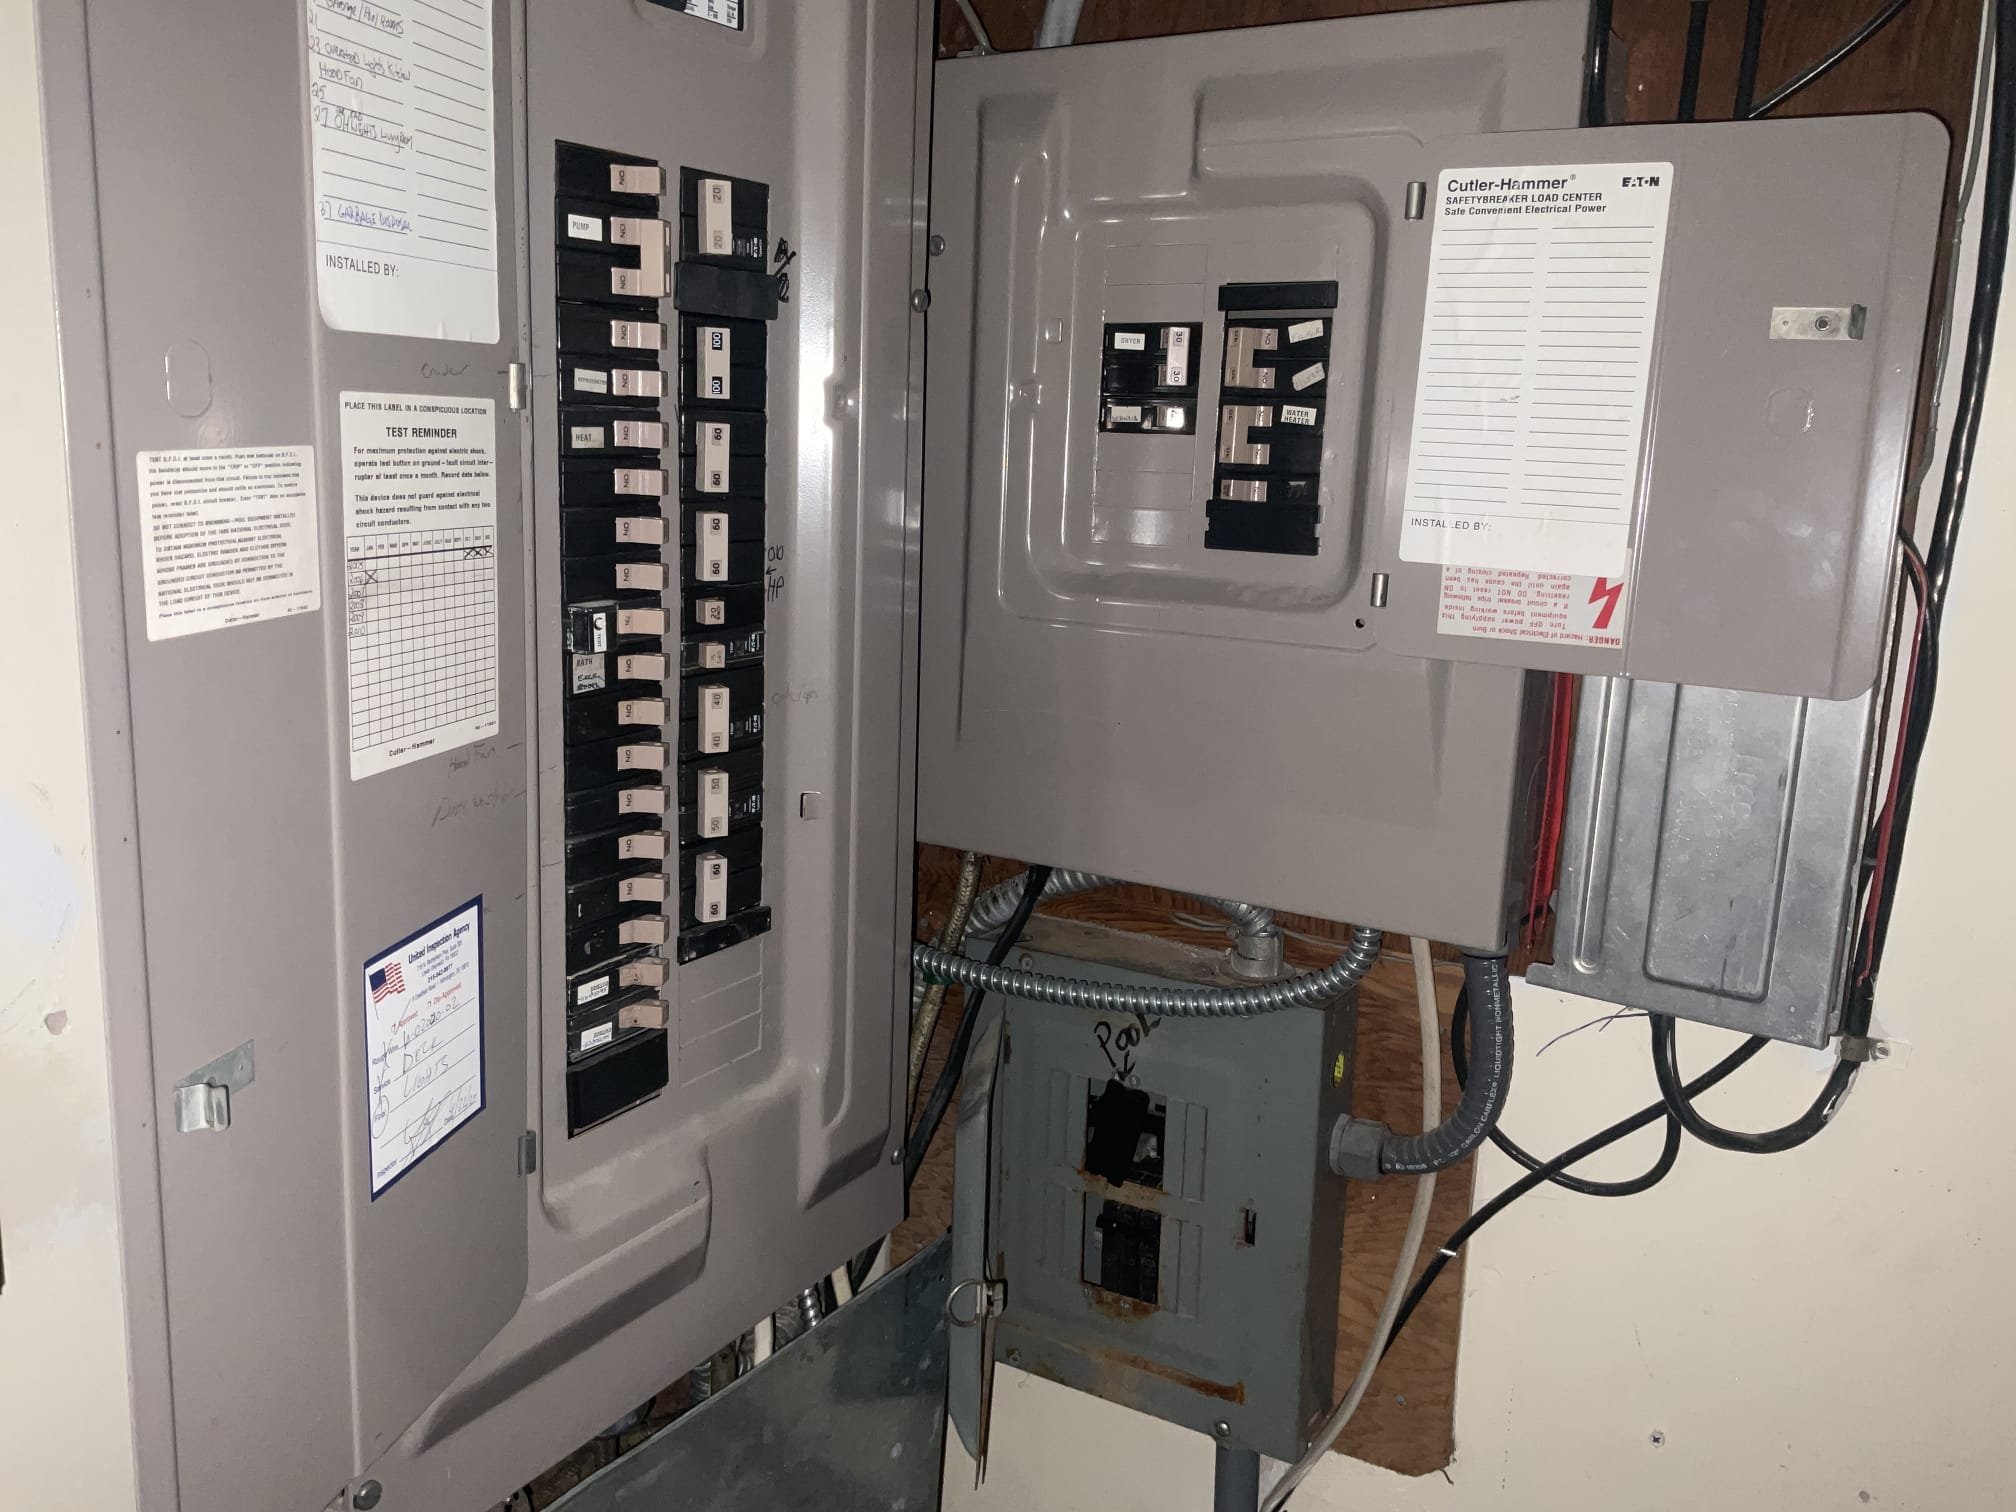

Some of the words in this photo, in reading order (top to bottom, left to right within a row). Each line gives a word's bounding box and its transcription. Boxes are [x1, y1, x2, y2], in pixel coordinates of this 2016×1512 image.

[312, 82, 327, 100] 25
[314, 105, 329, 128] 27
[618, 169, 625, 185] ON
[713, 187, 722, 201] 20
[1446, 193, 1529, 205] SAFETYBREAKER
[1531, 193, 1558, 203] LOAD
[1561, 192, 1602, 202] CENTER
[1445, 207, 1466, 217] Safe
[1468, 205, 1522, 216] Convenient
[1525, 204, 1572, 214] Electrical
[1575, 203, 1607, 213] Power
[572, 220, 590, 232] PUMP
[620, 223, 626, 239] ON
[714, 235, 723, 249] 20
[326, 254, 380, 275] INSTALLED
[384, 263, 399, 279] BY:
[619, 274, 626, 290] ON
[620, 325, 627, 340] ON
[1175, 331, 1183, 343] 30
[713, 333, 721, 348] 100
[622, 373, 629, 389] ON
[1173, 370, 1181, 383] 30
[713, 379, 721, 394] 100
[345, 402, 365, 410] PLACE
[368, 402, 382, 410] THIS
[405, 404, 411, 412] IN
[419, 405, 459, 414] CONSPICUOUS
[461, 407, 487, 415] LOCATION
[1286, 409, 1309, 418] WATER
[1284, 416, 1309, 425] HEATER
[386, 427, 408, 438] TEST
[412, 428, 457, 439] REMINDER
[575, 433, 592, 442] HEAT
[623, 425, 629, 440] ON
[713, 428, 722, 440] 60
[353, 447, 365, 455] For
[366, 447, 395, 455] maximum
[398, 447, 426, 456] protection
[427, 448, 447, 456] against
[354, 460, 377, 468] operate
[392, 459, 411, 467] button
[623, 473, 629, 488] ON
[712, 473, 721, 486] 60
[355, 494, 368, 502] This
[418, 492, 434, 500] guard
[436, 491, 455, 499] against
[356, 507, 373, 515] shock
[375, 506, 395, 514] hazard
[397, 505, 422, 513] resulting
[356, 520, 376, 528] circuit
[378, 518, 411, 527] conductors.
[624, 521, 630, 536] ON
[712, 518, 720, 531] 60
[624, 567, 630, 582] ON
[712, 562, 720, 576] 60
[1467, 567, 1493, 576] closing
[1497, 570, 1530, 579] Repeated
[767, 575, 785, 602] HP
[711, 607, 717, 619] 20
[1441, 612, 1455, 620] this
[1470, 605, 1498, 614] working
[1503, 609, 1525, 617] before
[1530, 611, 1567, 620] equipment
[1460, 613, 1496, 622] supplying
[1472, 625, 1488, 634] Burn
[1498, 628, 1518, 636] Shock
[1549, 621, 1565, 630] Turn
[1520, 629, 1549, 639] Electrical
[625, 658, 632, 673] ON
[714, 693, 721, 706] 40
[626, 704, 632, 718] ON
[714, 735, 721, 748] 40
[625, 749, 632, 763] ON
[712, 778, 720, 790] 50
[626, 794, 632, 807] ON
[711, 819, 720, 832] 50
[626, 839, 632, 853] ON
[713, 864, 721, 876] 60
[627, 882, 633, 896] ON
[711, 904, 719, 916] 60
[408, 946, 425, 964] United
[427, 933, 452, 954] Inspection
[453, 921, 471, 939] Agency
